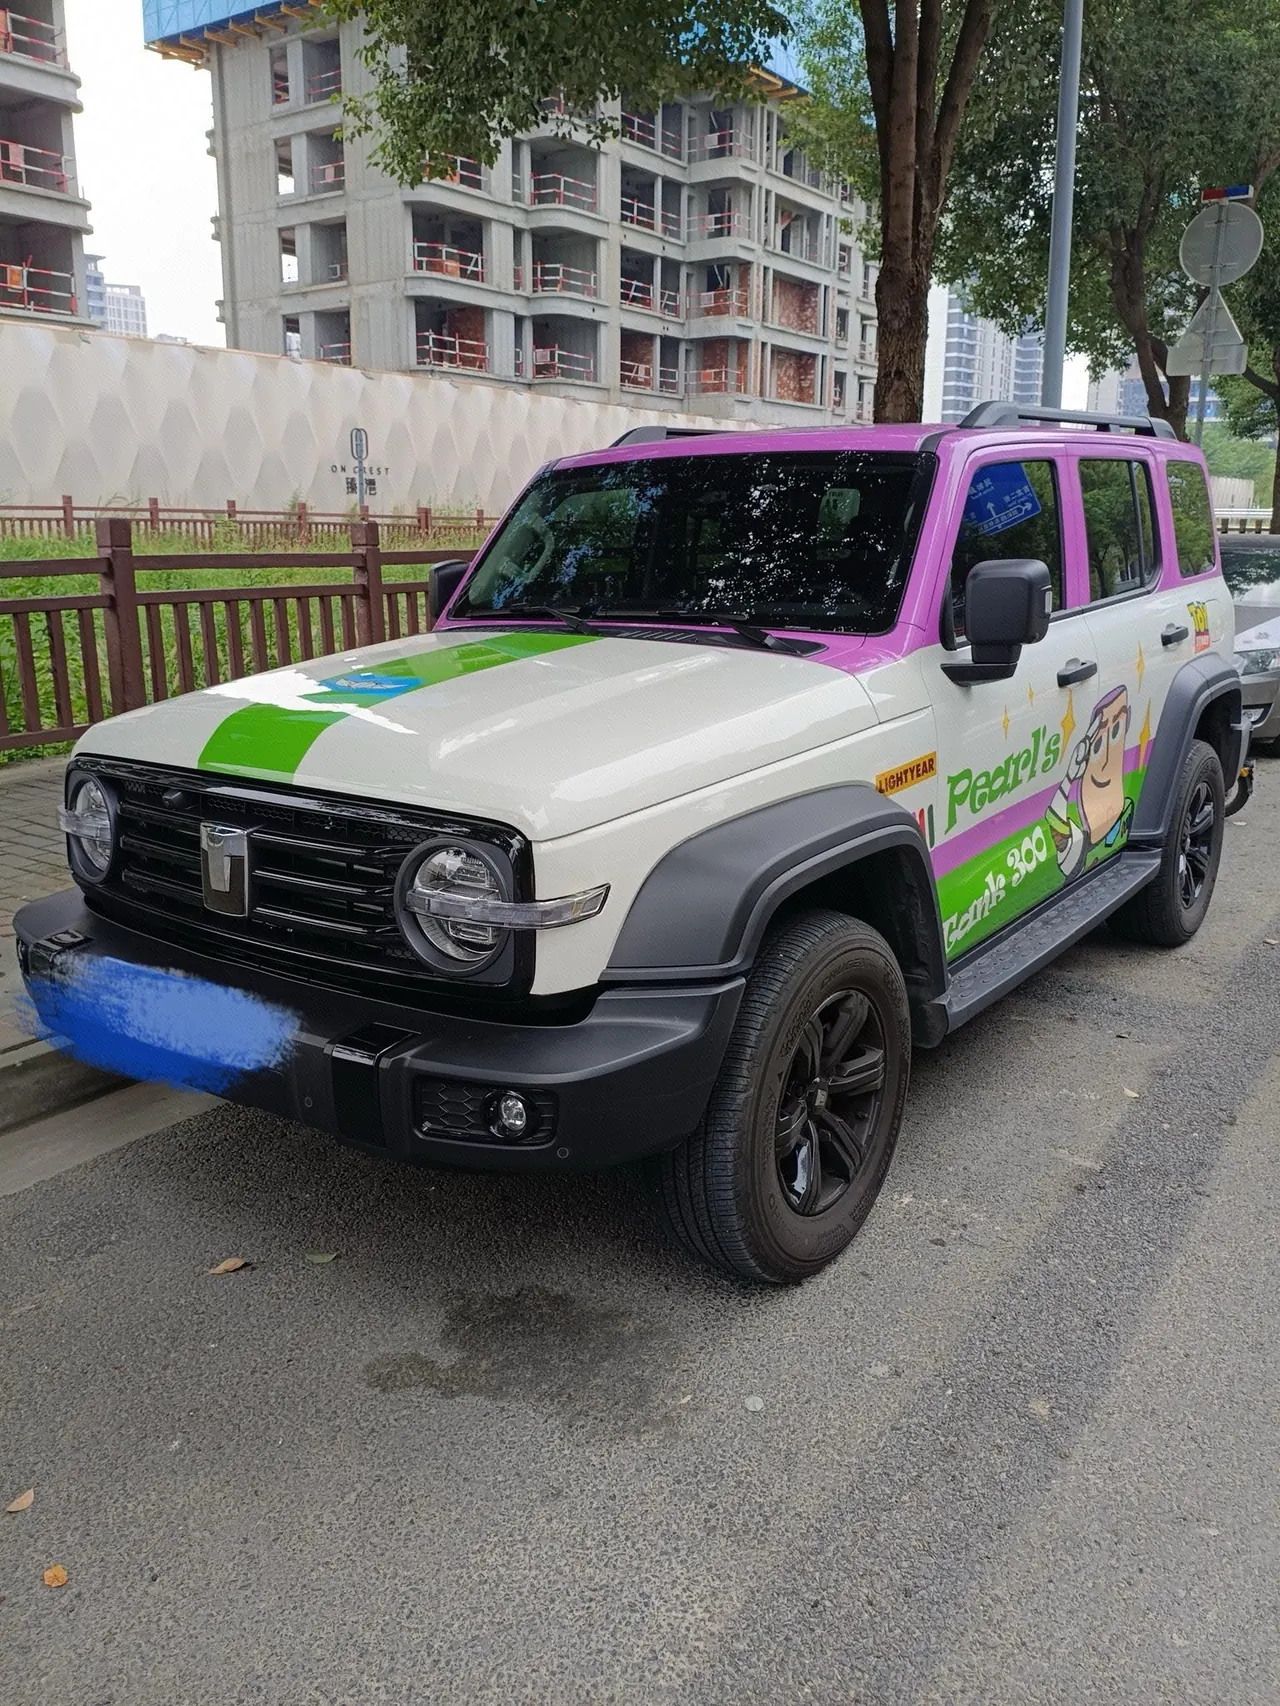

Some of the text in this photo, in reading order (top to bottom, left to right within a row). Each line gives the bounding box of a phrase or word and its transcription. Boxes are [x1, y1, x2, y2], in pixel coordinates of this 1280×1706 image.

[330, 464, 346, 473] ON
[877, 757, 935, 794] LIGHTYEAR
[944, 724, 1061, 836] Pearl's
[1006, 825, 1047, 888] 300
